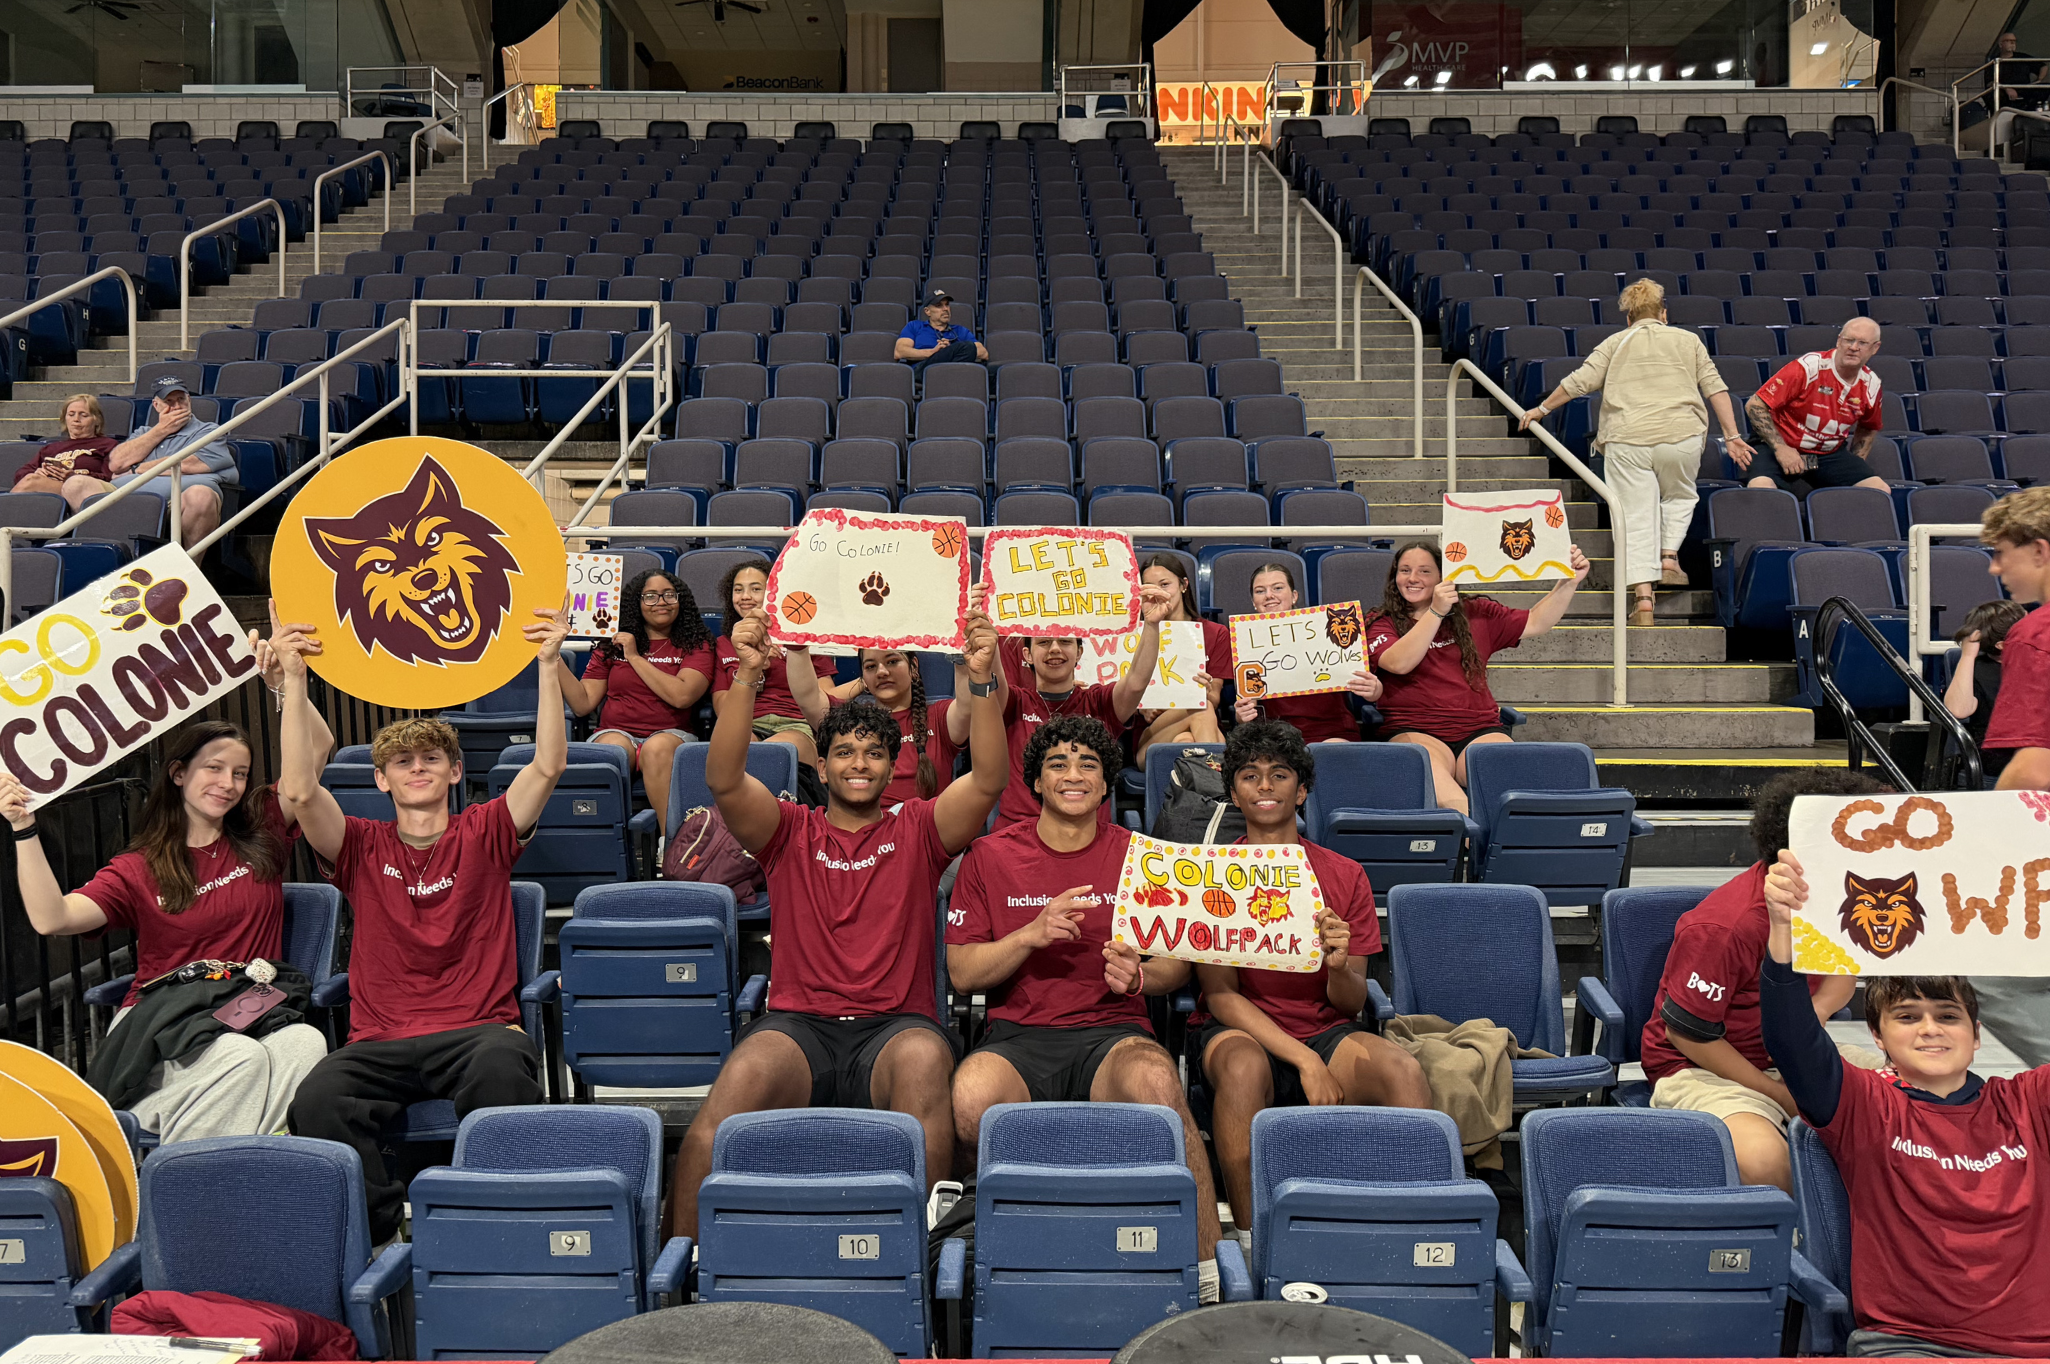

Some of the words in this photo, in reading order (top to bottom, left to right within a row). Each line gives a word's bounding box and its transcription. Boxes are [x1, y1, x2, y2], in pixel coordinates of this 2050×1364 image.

[1411, 42, 1469, 63] MVP
[736, 76, 824, 88] BeaconBank
[138, 284, 144, 295] J
[82, 308, 89, 320] H
[18, 338, 26, 351] G
[1468, 333, 1475, 345] G
[1503, 365, 1509, 379] F
[1009, 540, 1110, 574] LET'S
[1713, 550, 1722, 568] B
[588, 566, 614, 585] GO
[1052, 567, 1087, 591] GO
[569, 591, 609, 611] NIE
[996, 591, 1128, 620] COLONIE
[1248, 620, 1317, 649] LETS
[1798, 619, 1809, 639] A
[1090, 629, 1173, 657] WOF
[0, 613, 101, 706] GO
[1261, 650, 1298, 670] GO
[0, 603, 256, 794] COLONIE
[1831, 796, 1954, 853] GO
[214, 865, 250, 889] Needs
[1141, 851, 1302, 890] COLONIE
[417, 876, 454, 896] Needs
[1129, 914, 1302, 956] WOLFPACK
[676, 966, 686, 979] 9
[1955, 1153, 2003, 1172] Needs
[564, 1235, 576, 1252] 9
[849, 1238, 869, 1255] 10
[1131, 1231, 1144, 1247] 11
[1425, 1247, 1444, 1263] 12
[1720, 1252, 1739, 1269] 13
